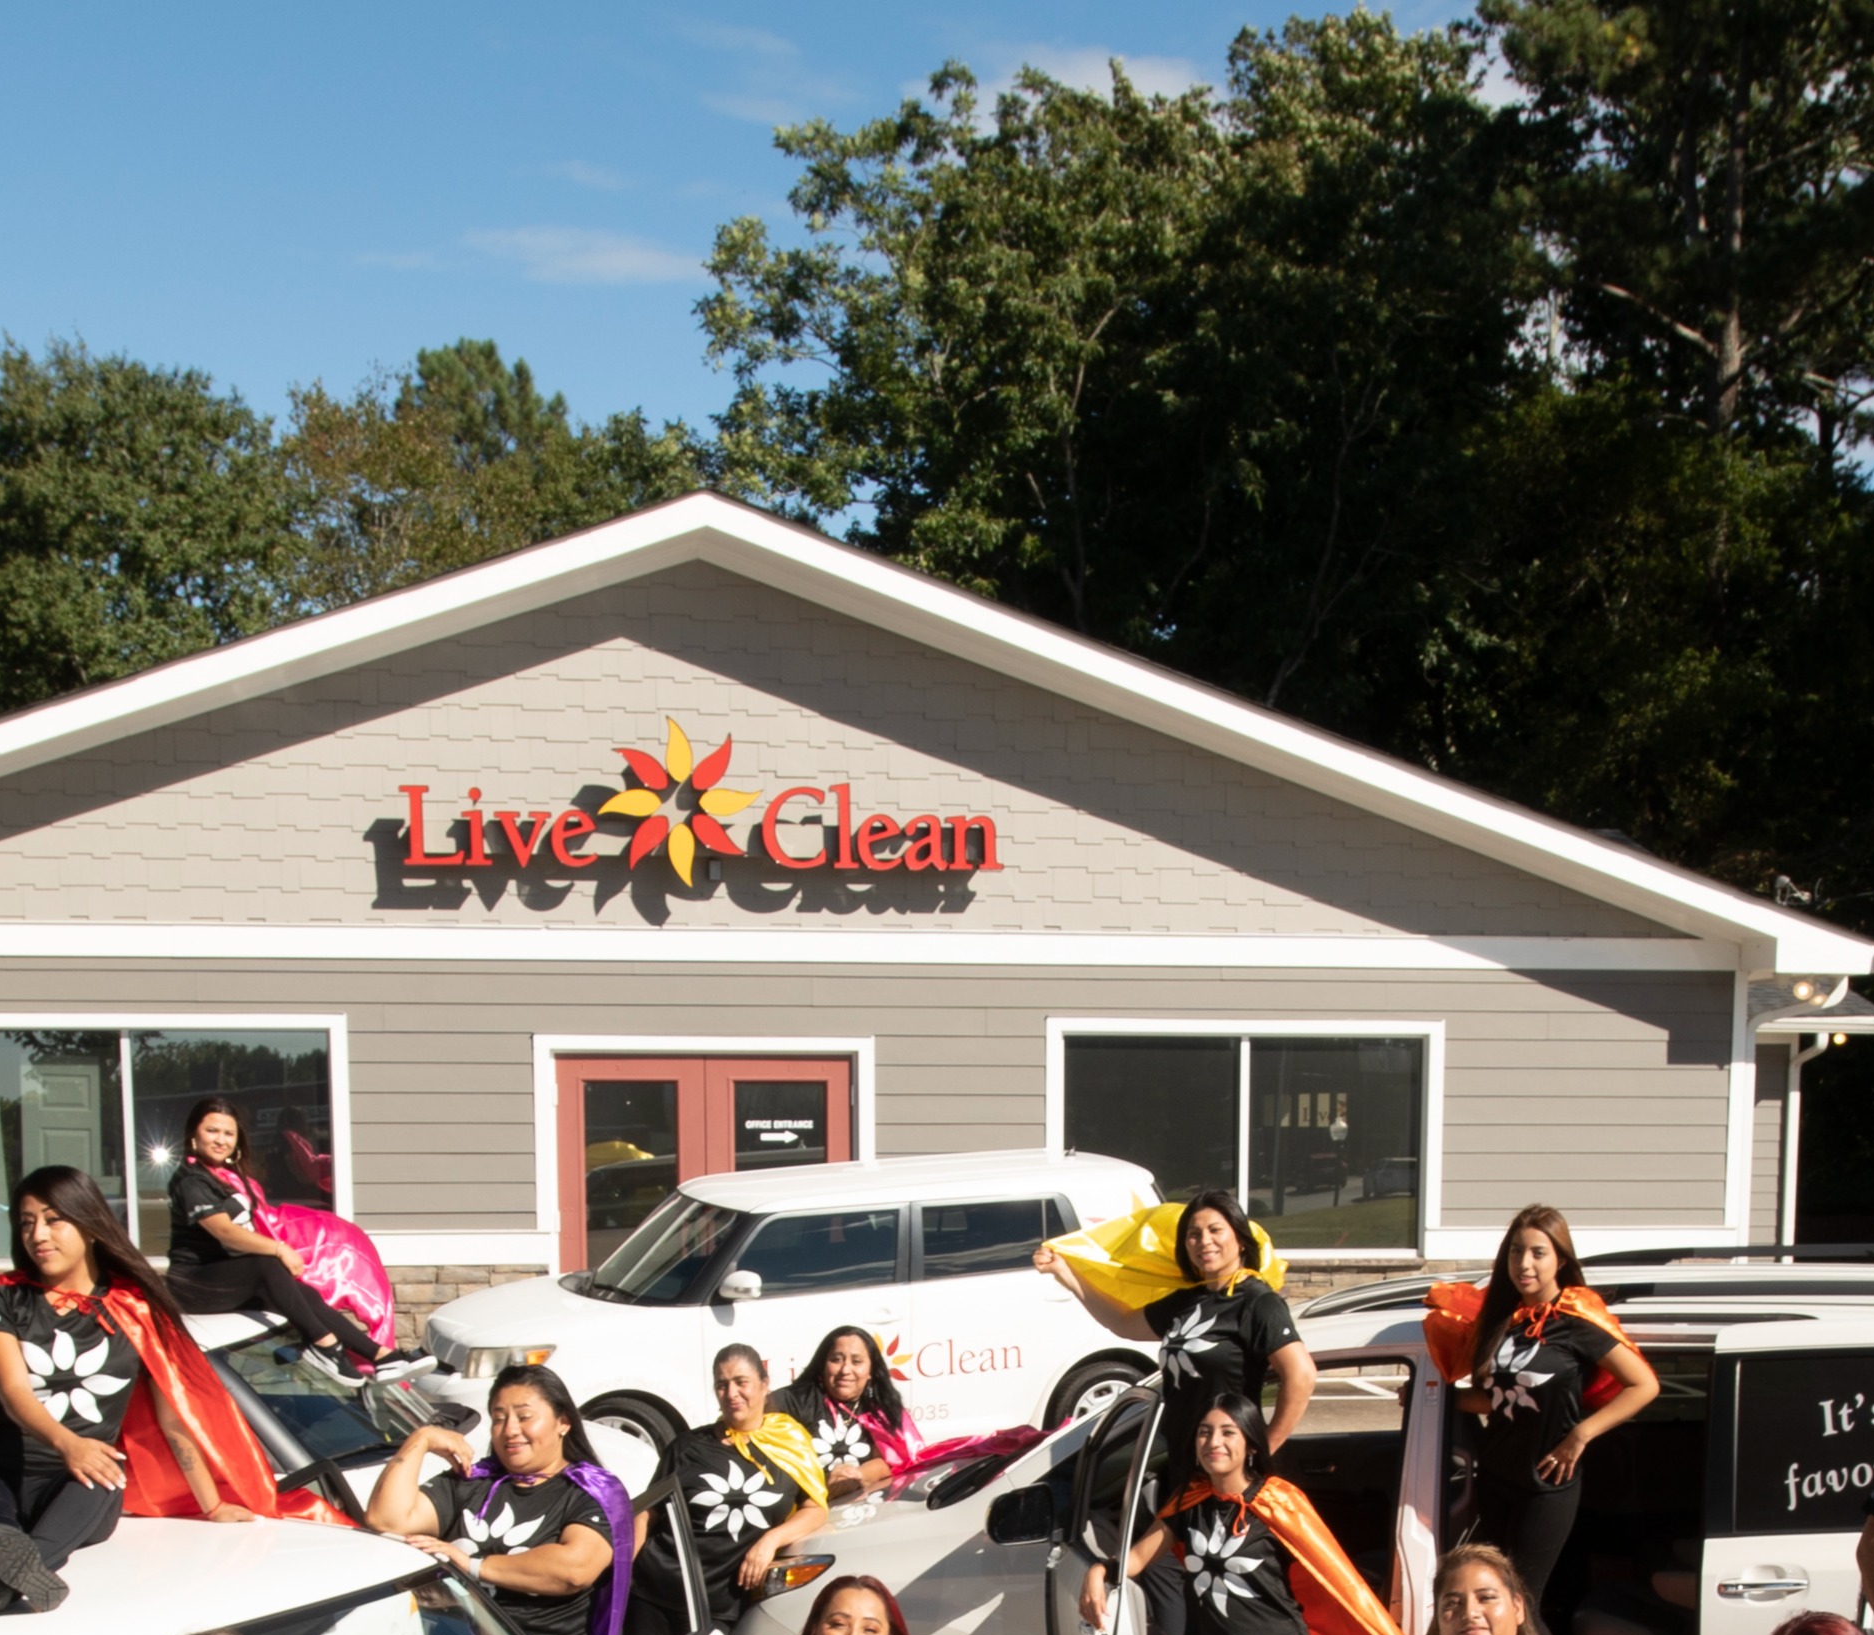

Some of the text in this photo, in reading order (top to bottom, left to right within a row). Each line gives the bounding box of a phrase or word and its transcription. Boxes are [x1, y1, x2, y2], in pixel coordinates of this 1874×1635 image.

[398, 782, 1005, 872] Live Clean
[916, 1338, 1024, 1379] Clean
